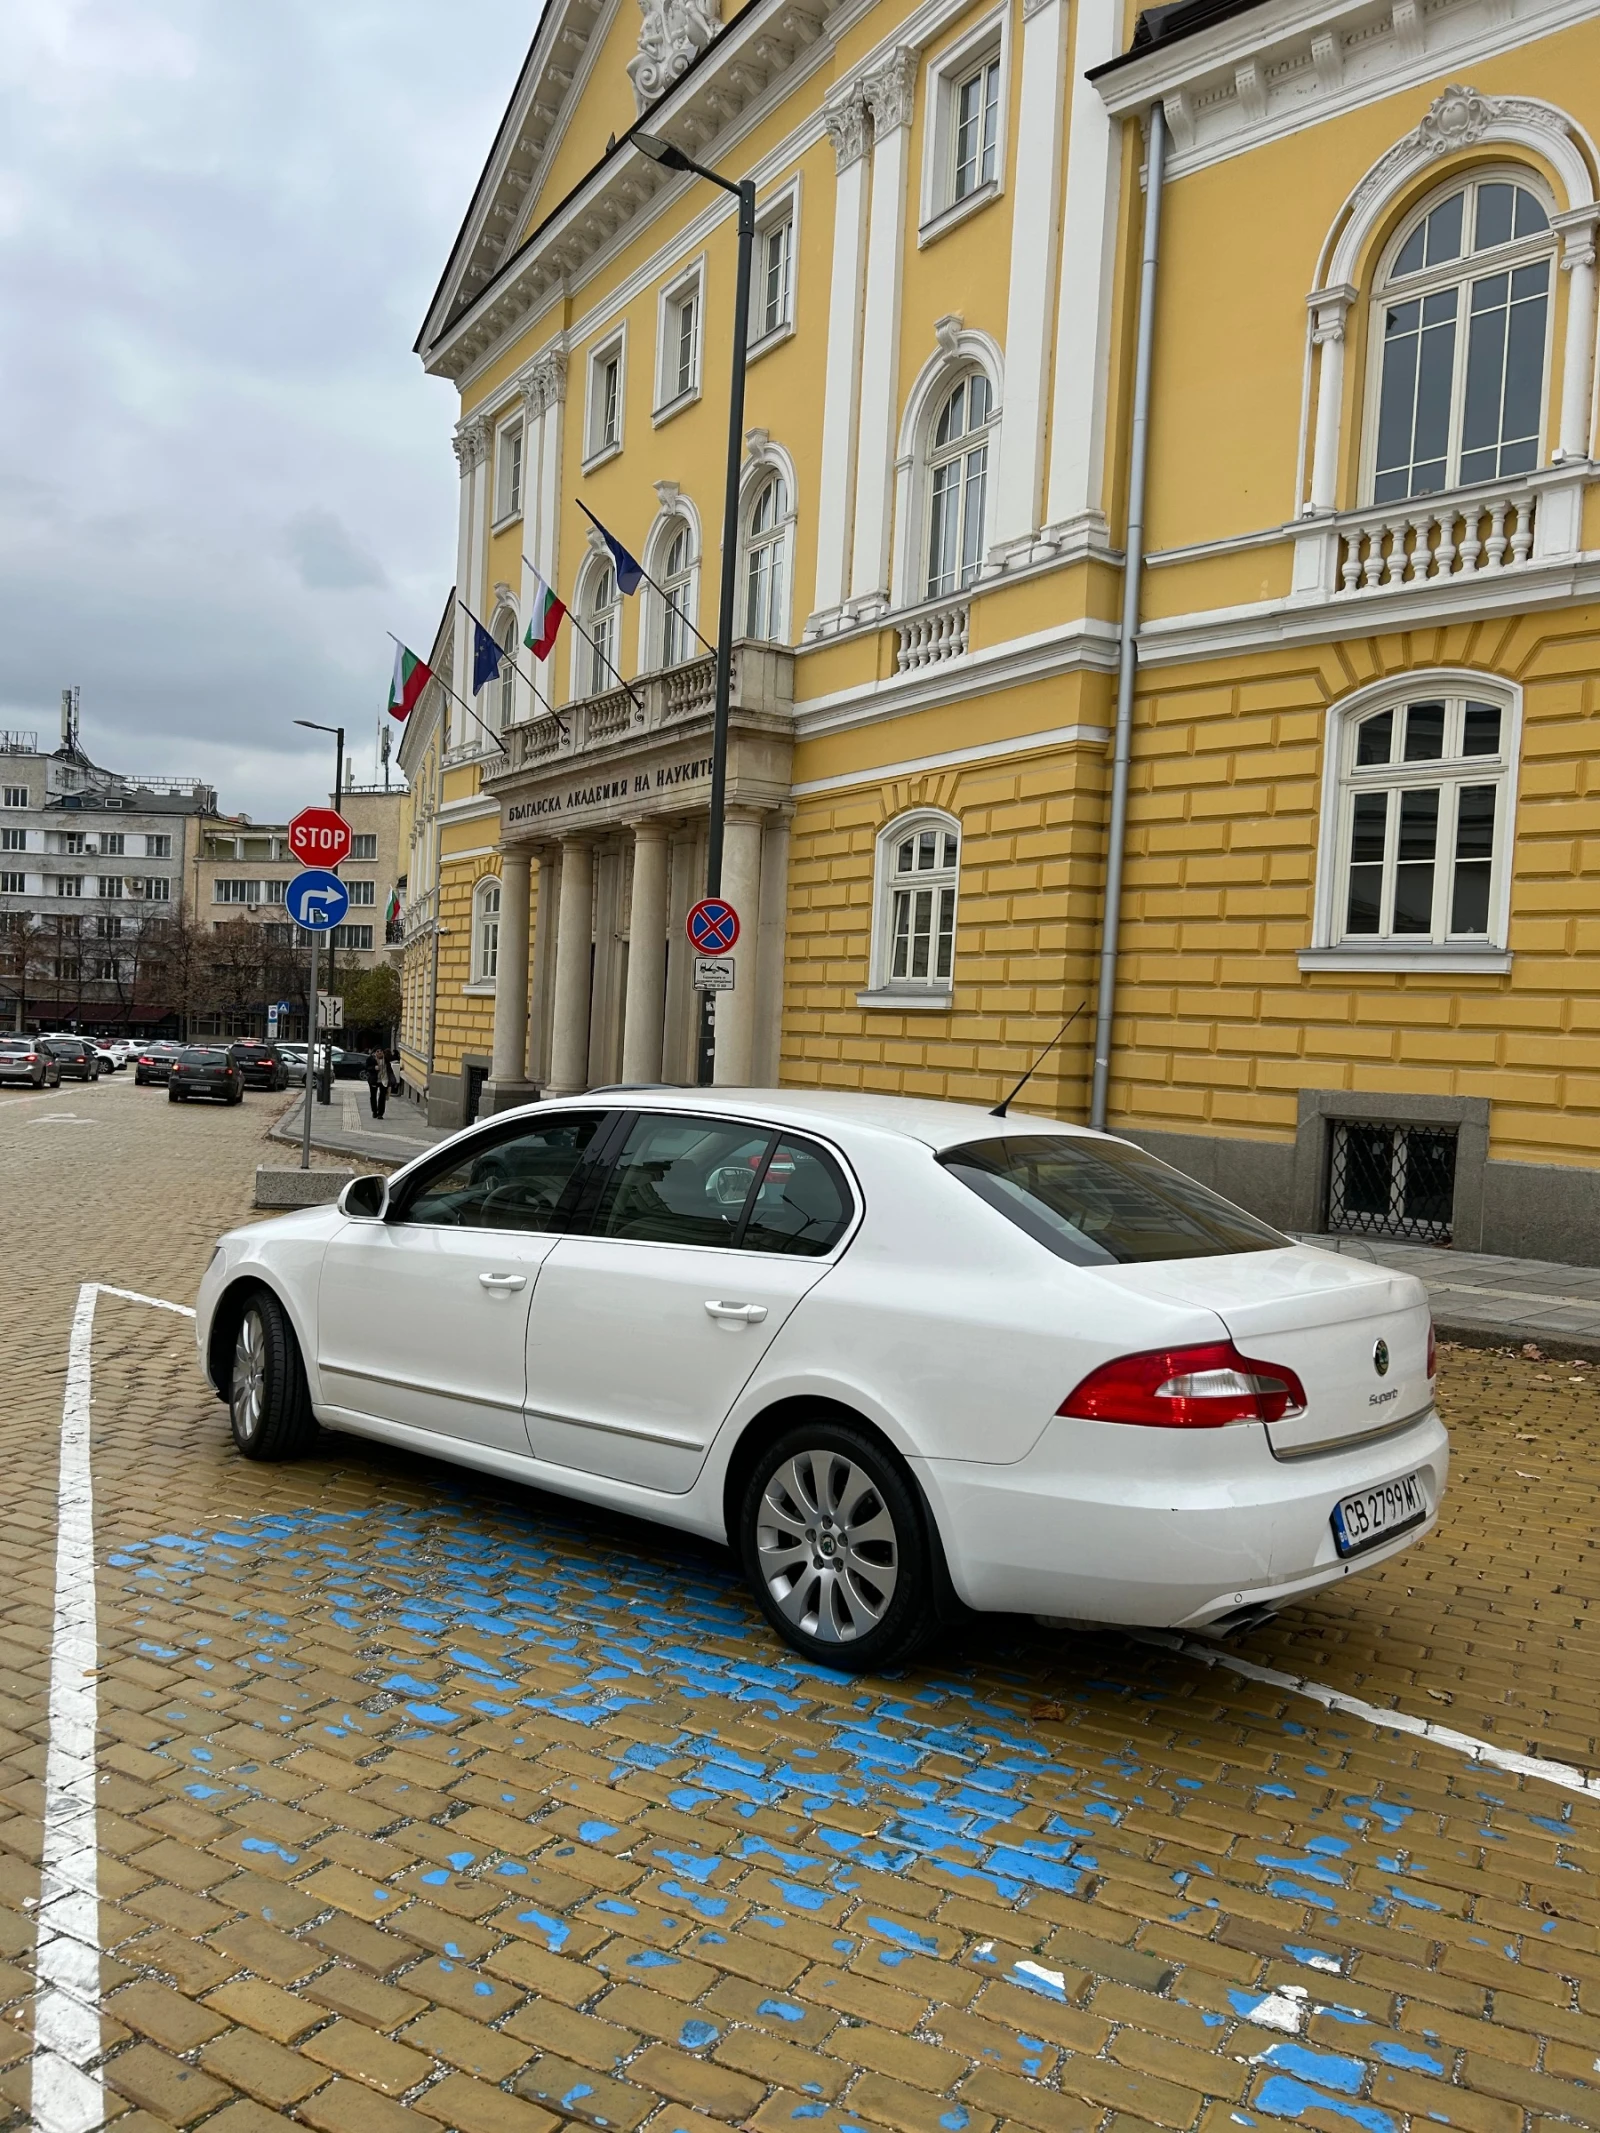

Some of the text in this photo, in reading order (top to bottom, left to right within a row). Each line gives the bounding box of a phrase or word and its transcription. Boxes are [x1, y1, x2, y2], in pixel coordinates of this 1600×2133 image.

[509, 757, 713, 821] БЪЛГАРСКА АКАДЕМИЯ НА НАУКИТЕ
[295, 826, 345, 849] STOP
[1368, 1388, 1398, 1407] Superb
[1367, 1483, 1404, 1527] 2799
